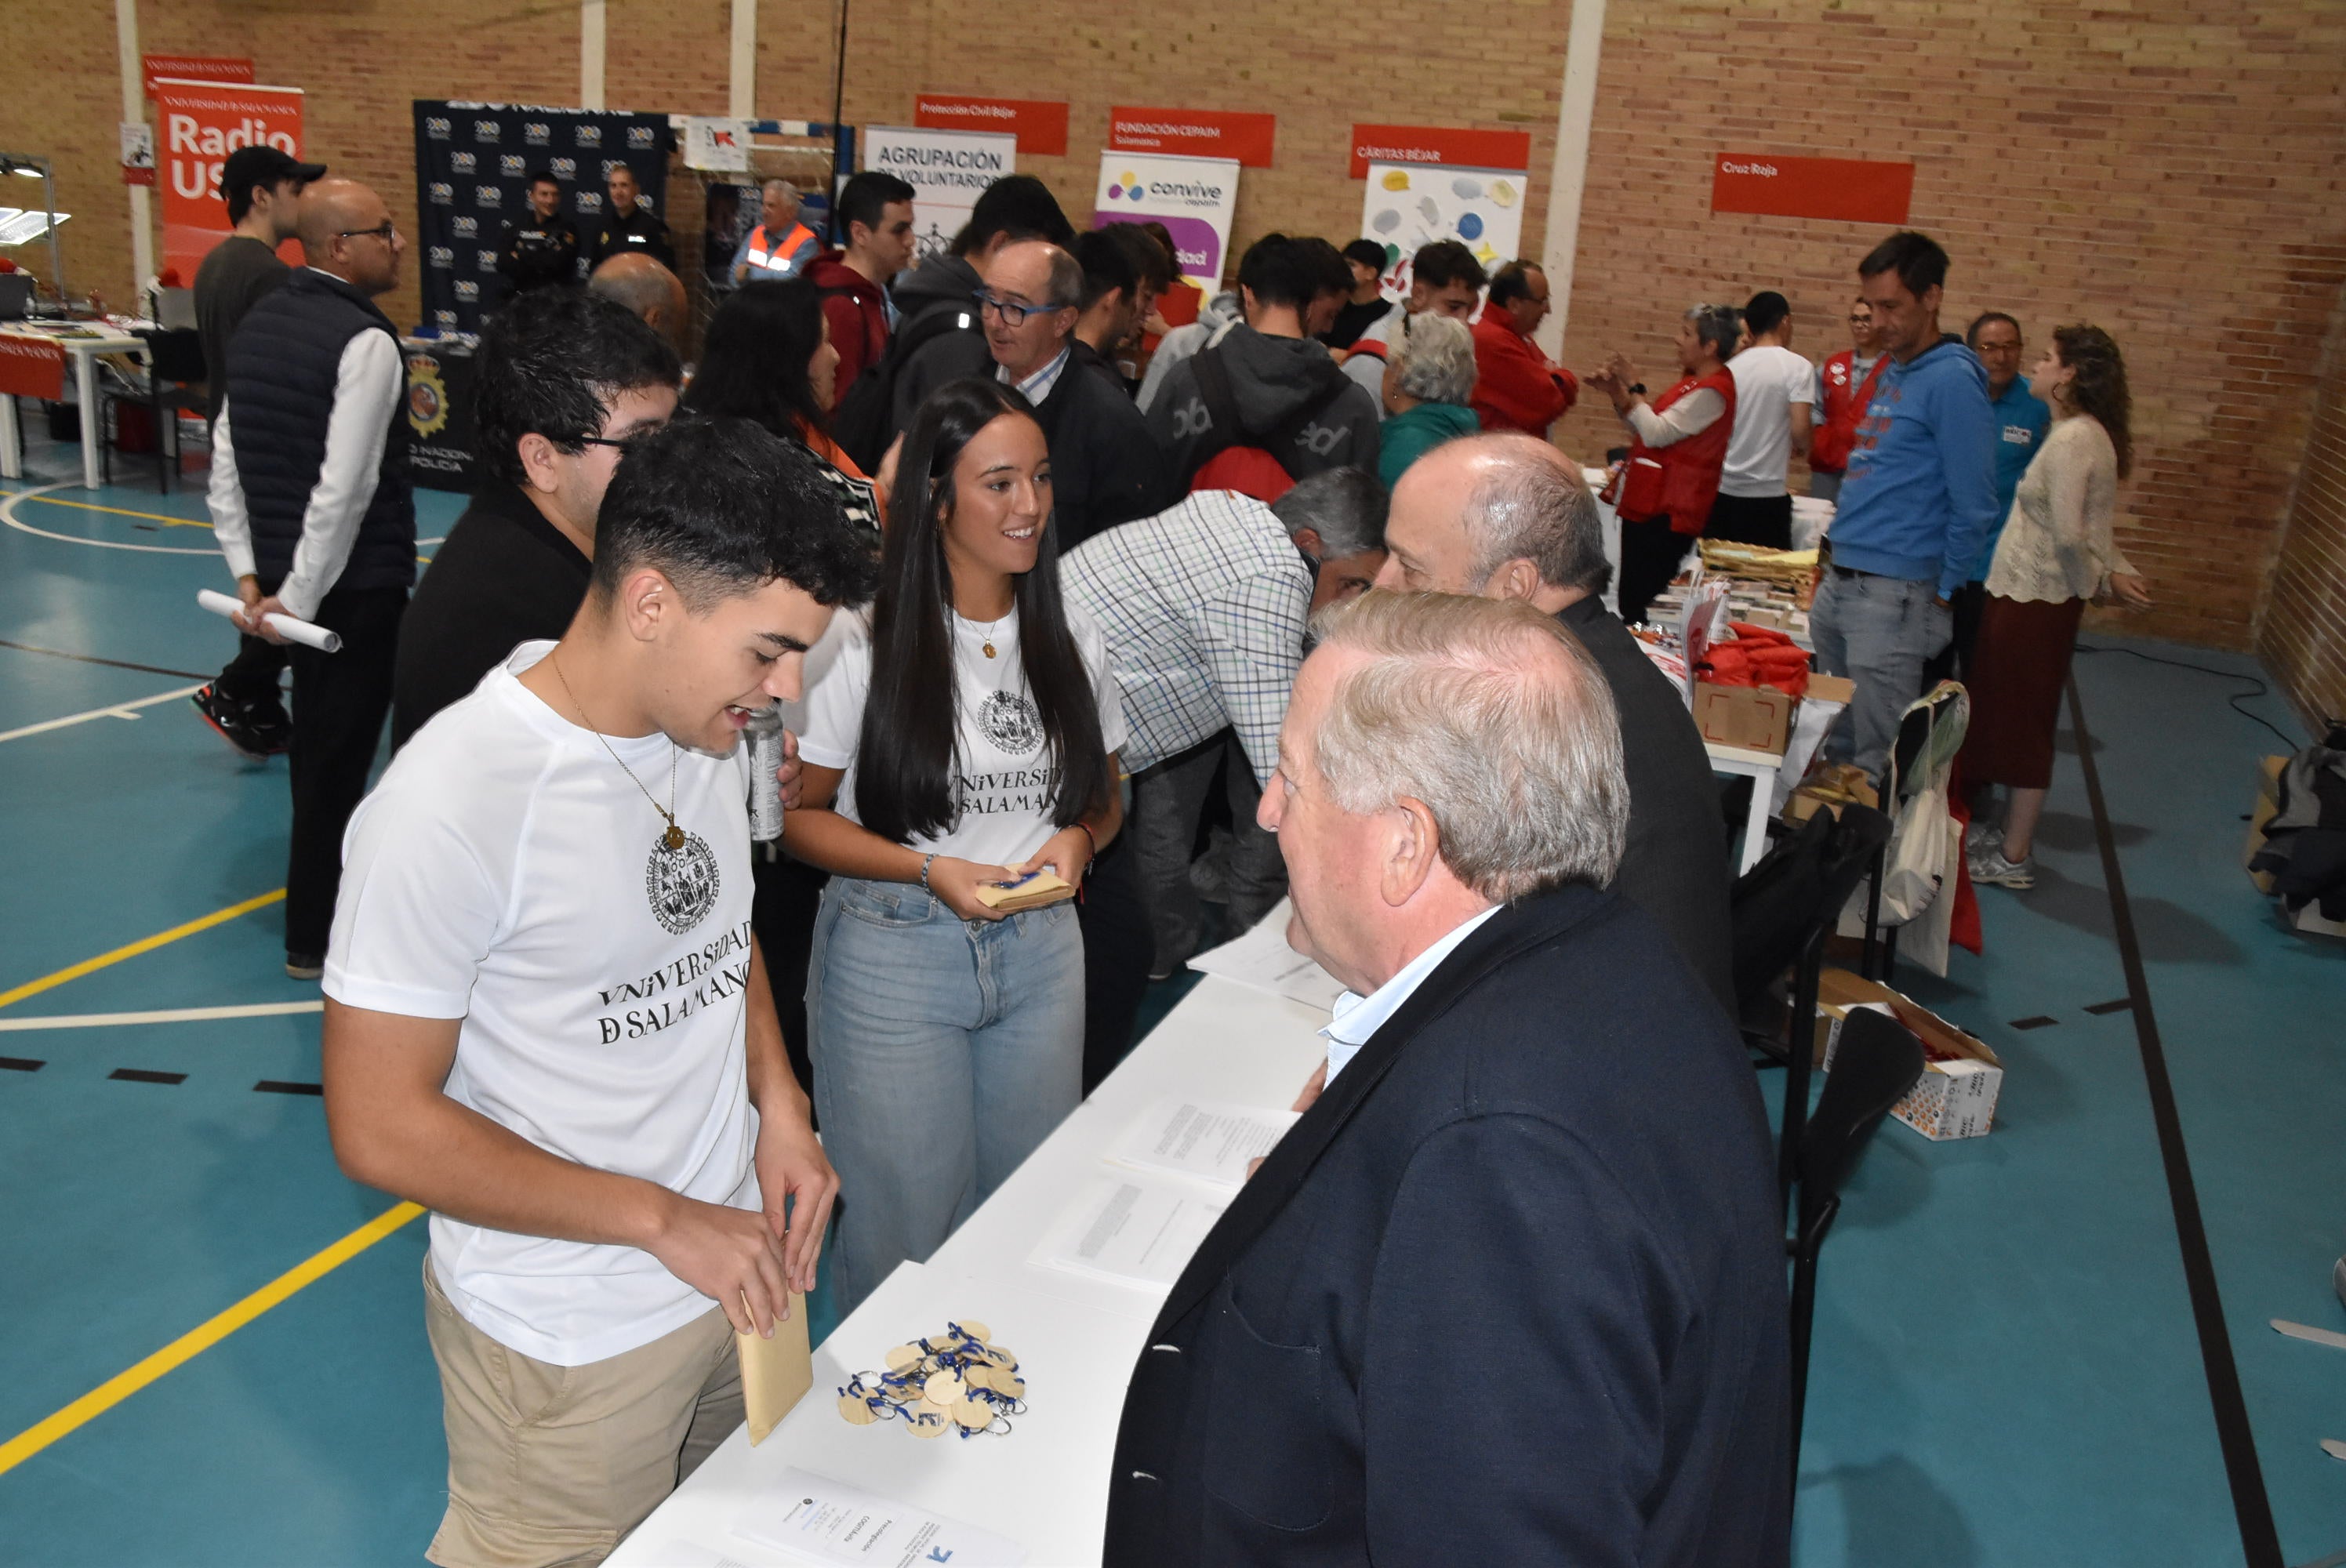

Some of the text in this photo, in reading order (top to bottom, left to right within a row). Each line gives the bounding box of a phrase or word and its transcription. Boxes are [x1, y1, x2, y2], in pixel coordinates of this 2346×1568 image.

[169, 113, 296, 158] Radio
[877, 146, 1003, 171] AGRUPACIÓN
[1721, 162, 1778, 178] Cruz Roja
[171, 159, 226, 201] US
[1150, 181, 1223, 199] convive
[958, 792, 1059, 815] SALAMAN
[626, 960, 750, 1040] SALAMANC
